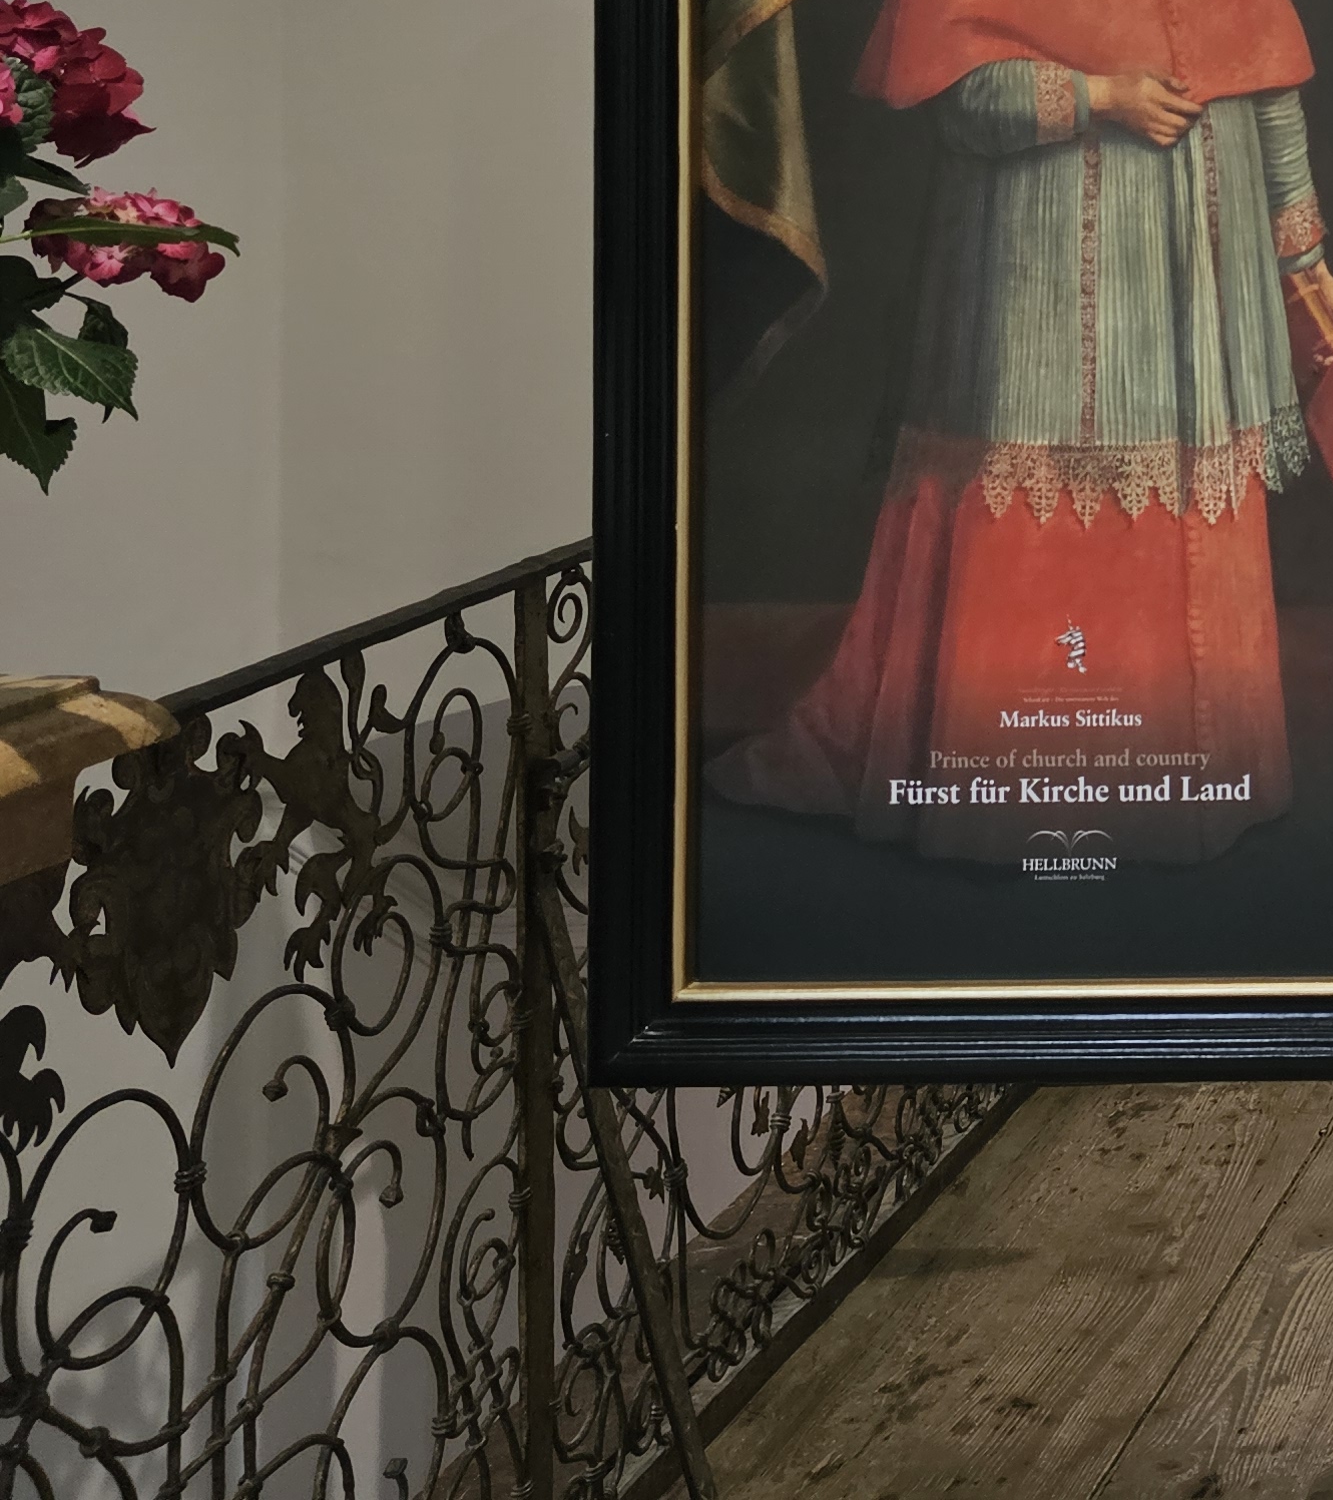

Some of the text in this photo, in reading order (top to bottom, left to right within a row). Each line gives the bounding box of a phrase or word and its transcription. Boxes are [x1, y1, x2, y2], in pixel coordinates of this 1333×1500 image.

[1000, 708, 1142, 728] Markus Sittikus
[930, 748, 1211, 770] Prince of church and country
[889, 774, 1251, 804] Fürst für Kirche und Land
[1022, 857, 1117, 871] HELLBRUNN
